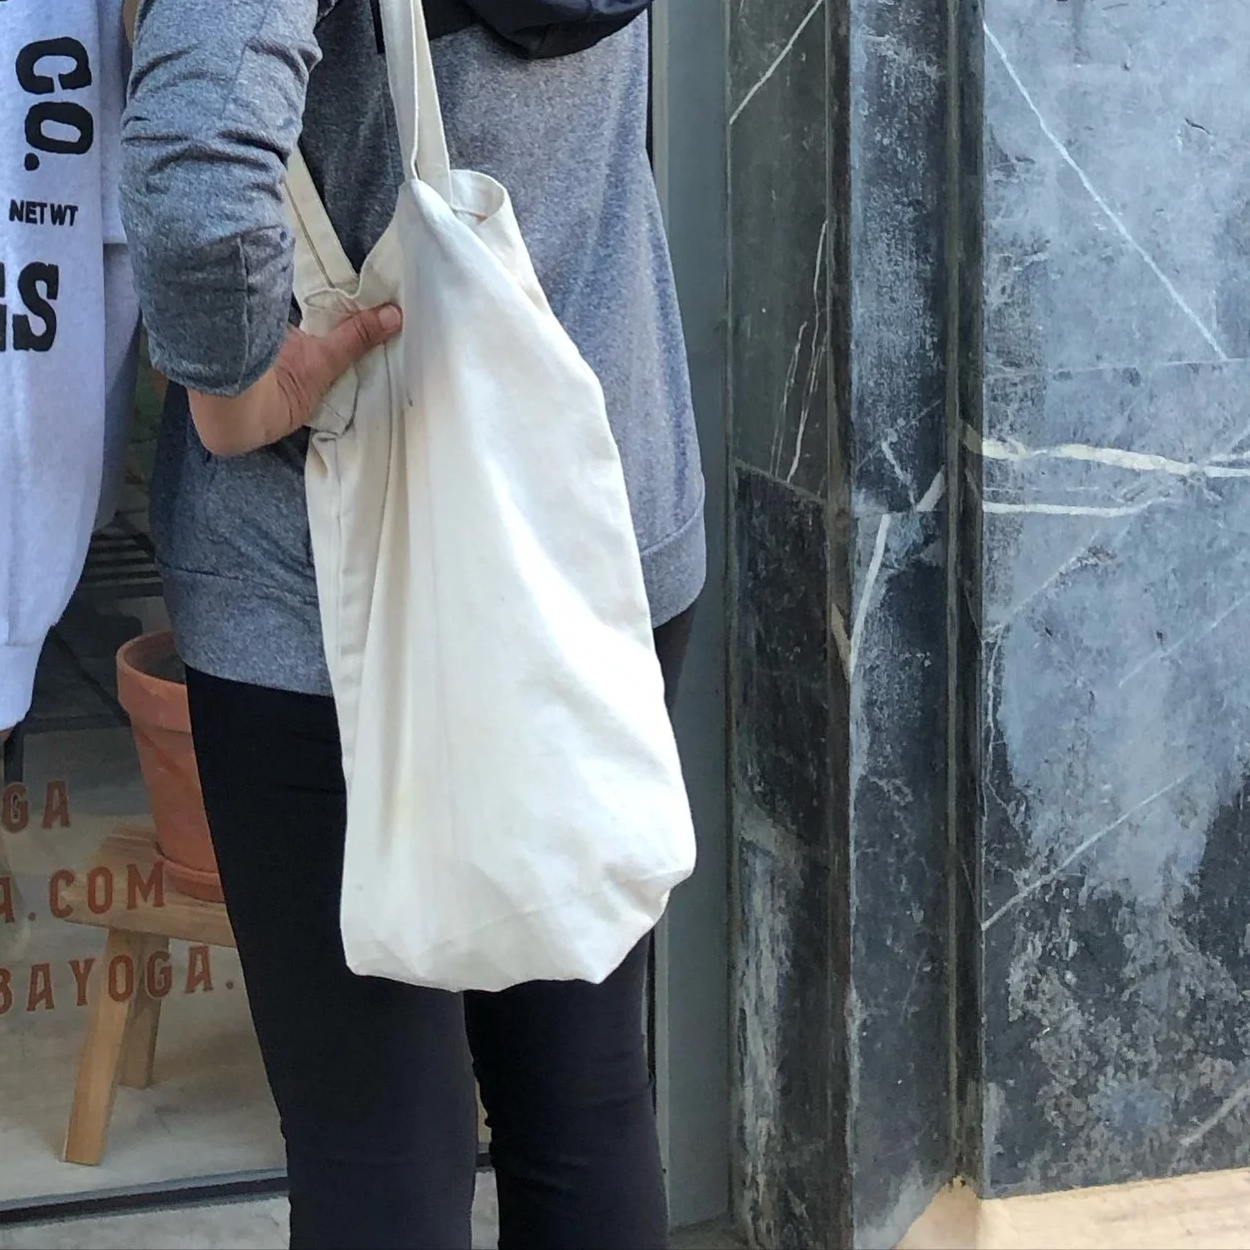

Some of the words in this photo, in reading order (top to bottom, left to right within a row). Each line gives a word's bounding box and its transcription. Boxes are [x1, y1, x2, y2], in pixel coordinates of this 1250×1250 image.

[15, 36, 94, 171] CO.
[8, 200, 49, 225] NET
[49, 204, 79, 227] WT
